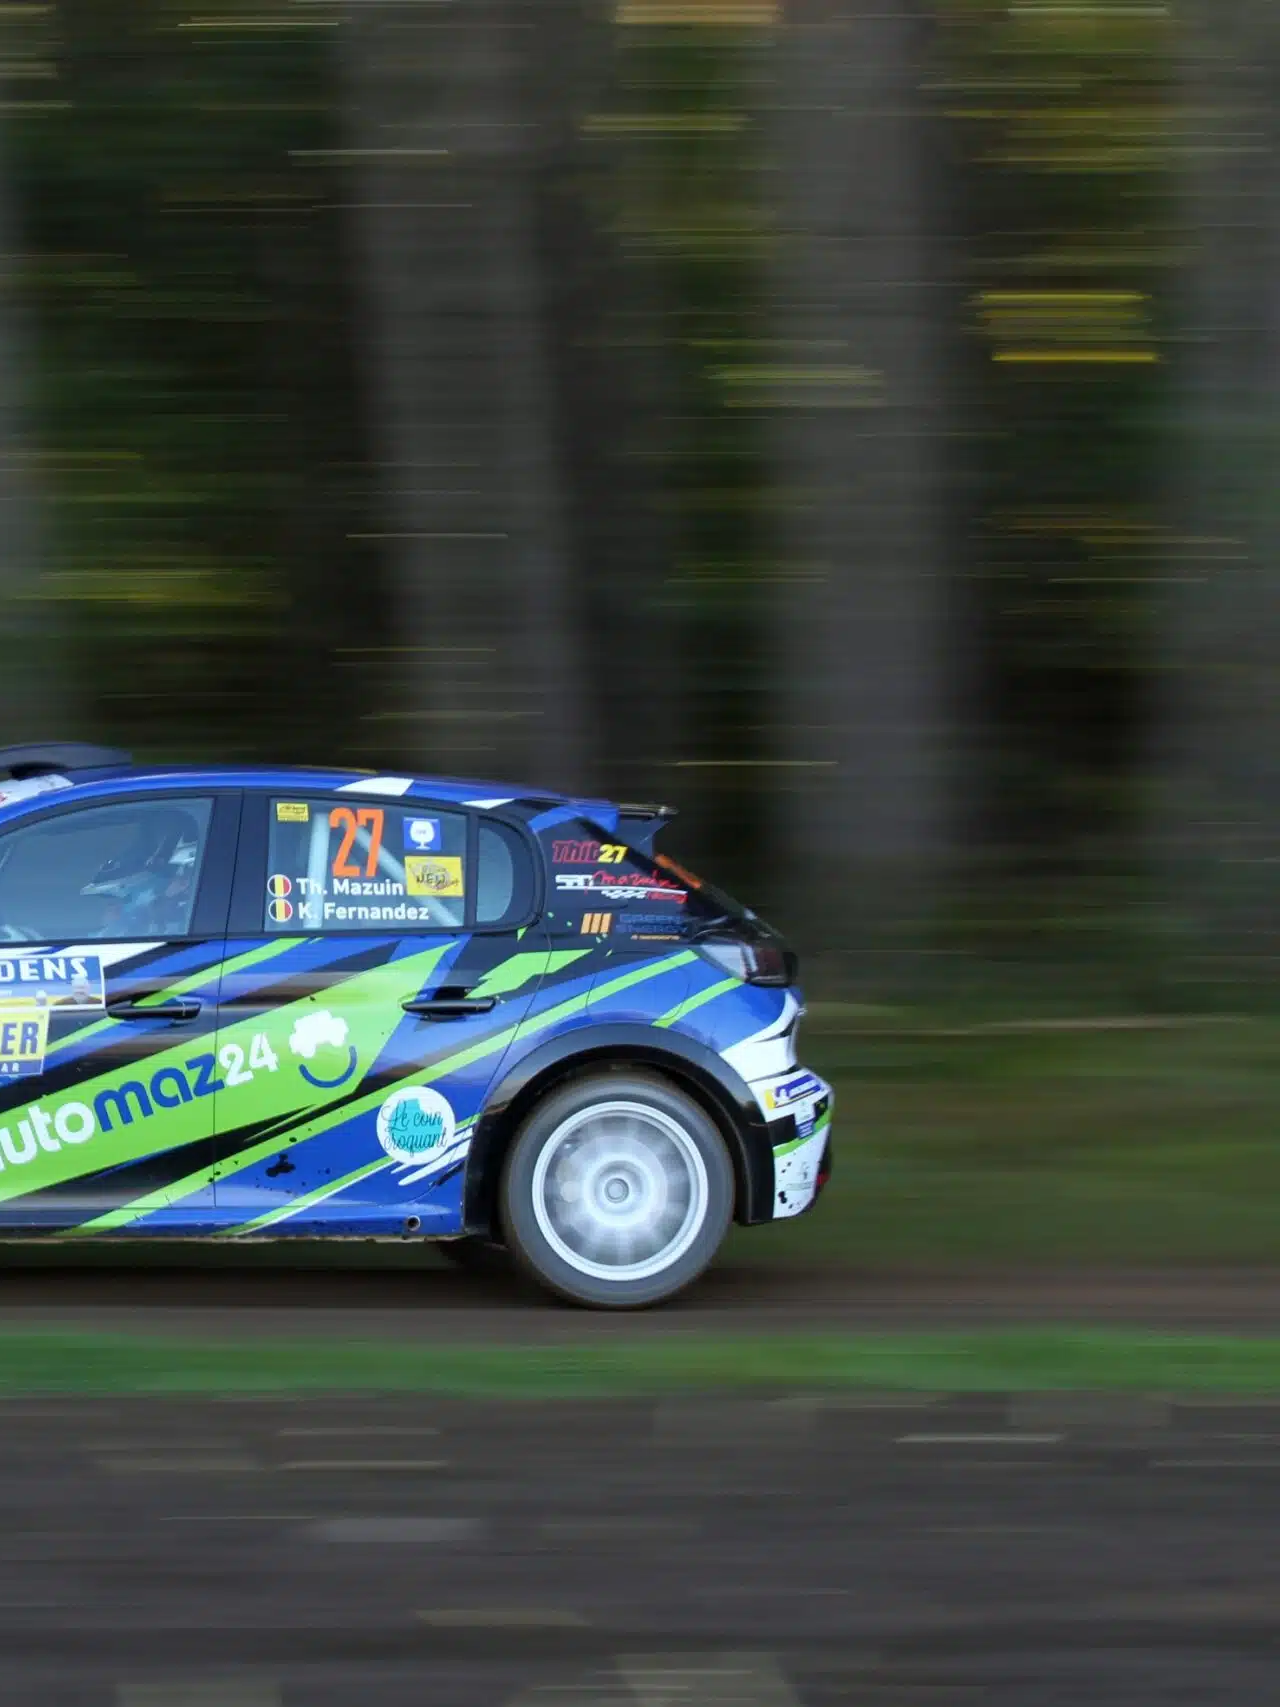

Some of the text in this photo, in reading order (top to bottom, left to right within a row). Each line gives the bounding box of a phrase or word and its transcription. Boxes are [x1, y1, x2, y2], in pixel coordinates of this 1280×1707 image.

[328, 806, 385, 878] 27
[296, 878, 404, 896] Th. Mazuin
[298, 902, 429, 920] K. Fernandez
